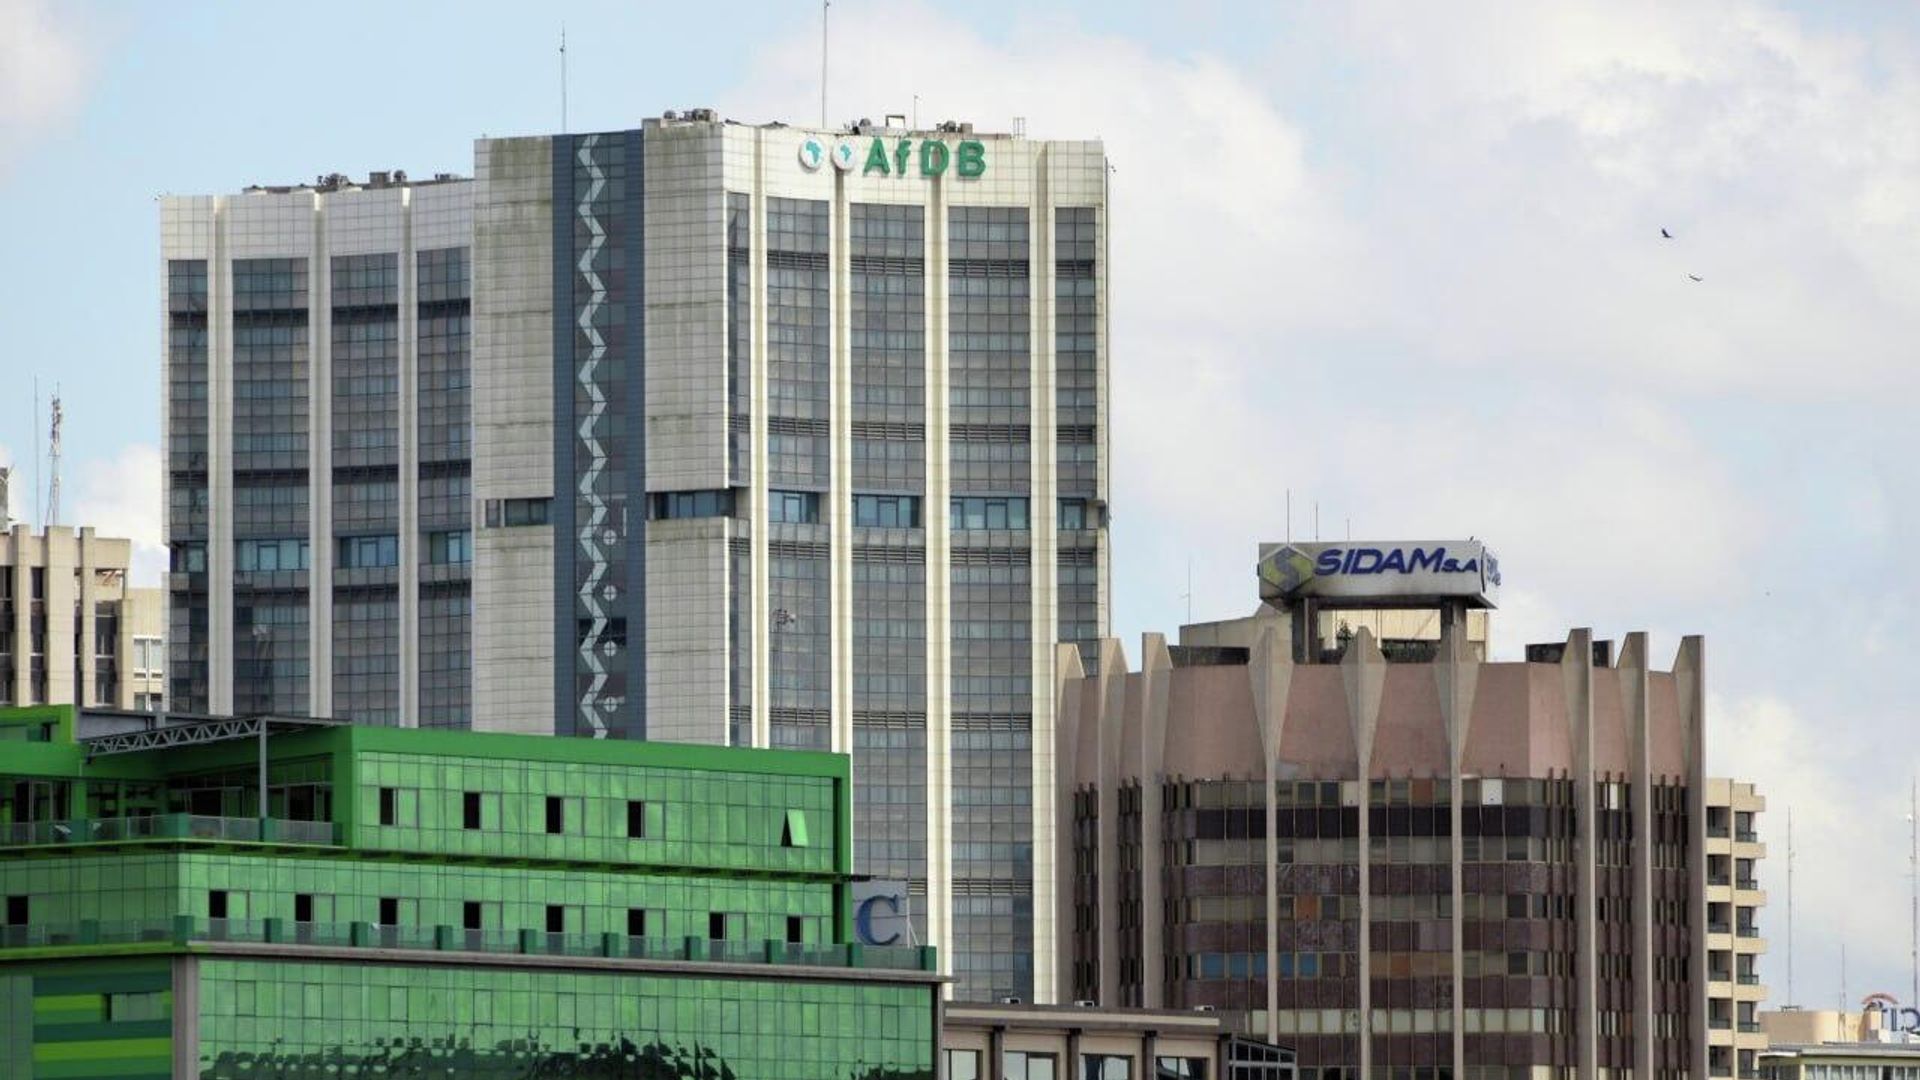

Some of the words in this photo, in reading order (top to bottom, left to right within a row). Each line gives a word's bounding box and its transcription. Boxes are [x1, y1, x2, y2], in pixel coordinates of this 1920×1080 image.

[863, 137, 986, 177] AfDB
[1315, 547, 1445, 576] SIDAM
[856, 894, 900, 946] C
